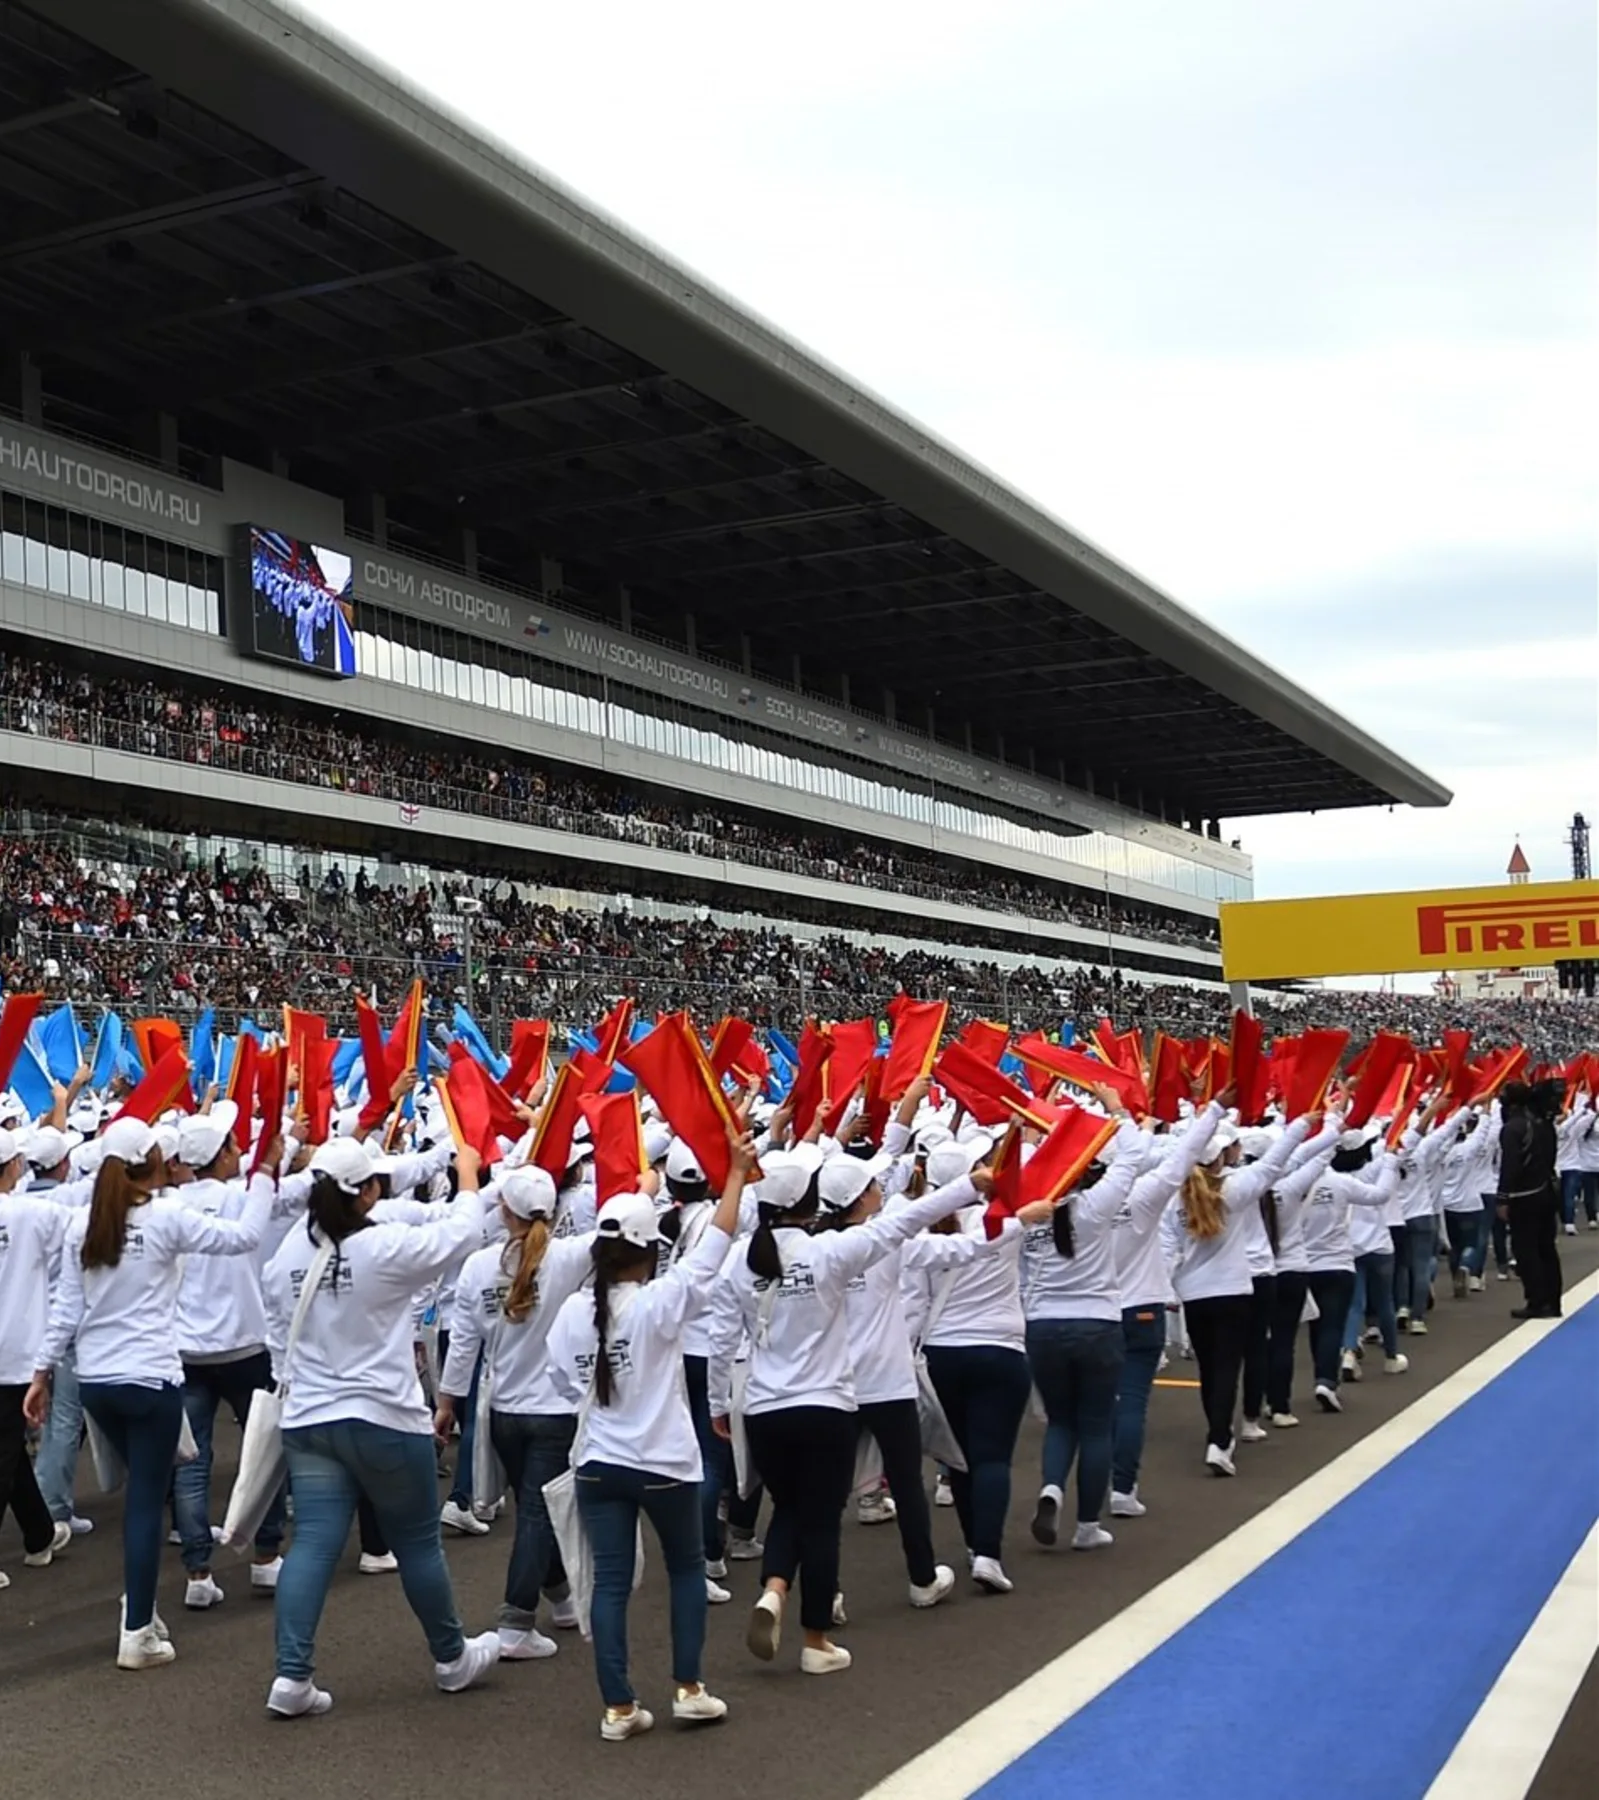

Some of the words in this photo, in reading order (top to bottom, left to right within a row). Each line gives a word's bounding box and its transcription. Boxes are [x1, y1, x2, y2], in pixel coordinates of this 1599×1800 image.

[364, 561, 415, 598] СОЧИ
[420, 579, 511, 630] АВТОДРОМ
[563, 626, 728, 699] WWW.SOCHIAUTODROM.RU
[290, 1267, 352, 1284] SHI
[753, 1274, 814, 1292] SCHI
